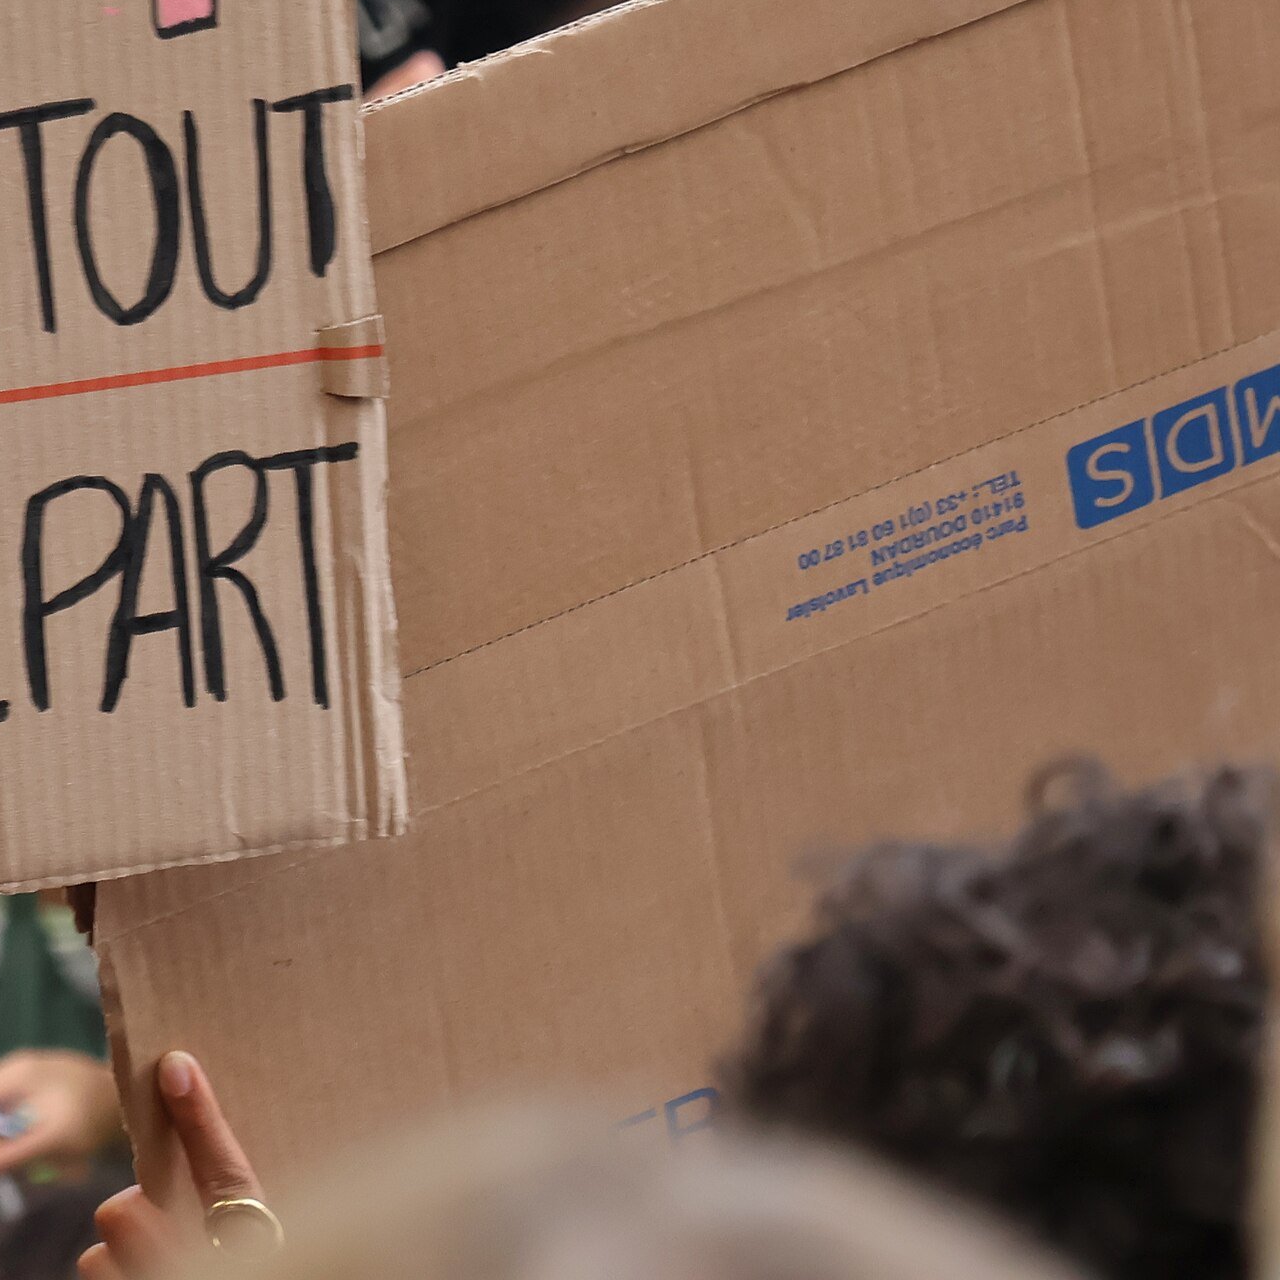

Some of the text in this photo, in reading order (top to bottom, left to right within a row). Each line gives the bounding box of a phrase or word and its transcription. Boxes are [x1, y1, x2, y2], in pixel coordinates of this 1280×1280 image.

[870, 515, 967, 566] DOURDAN
[986, 515, 1028, 540] Parc
[872, 532, 983, 586] économique
